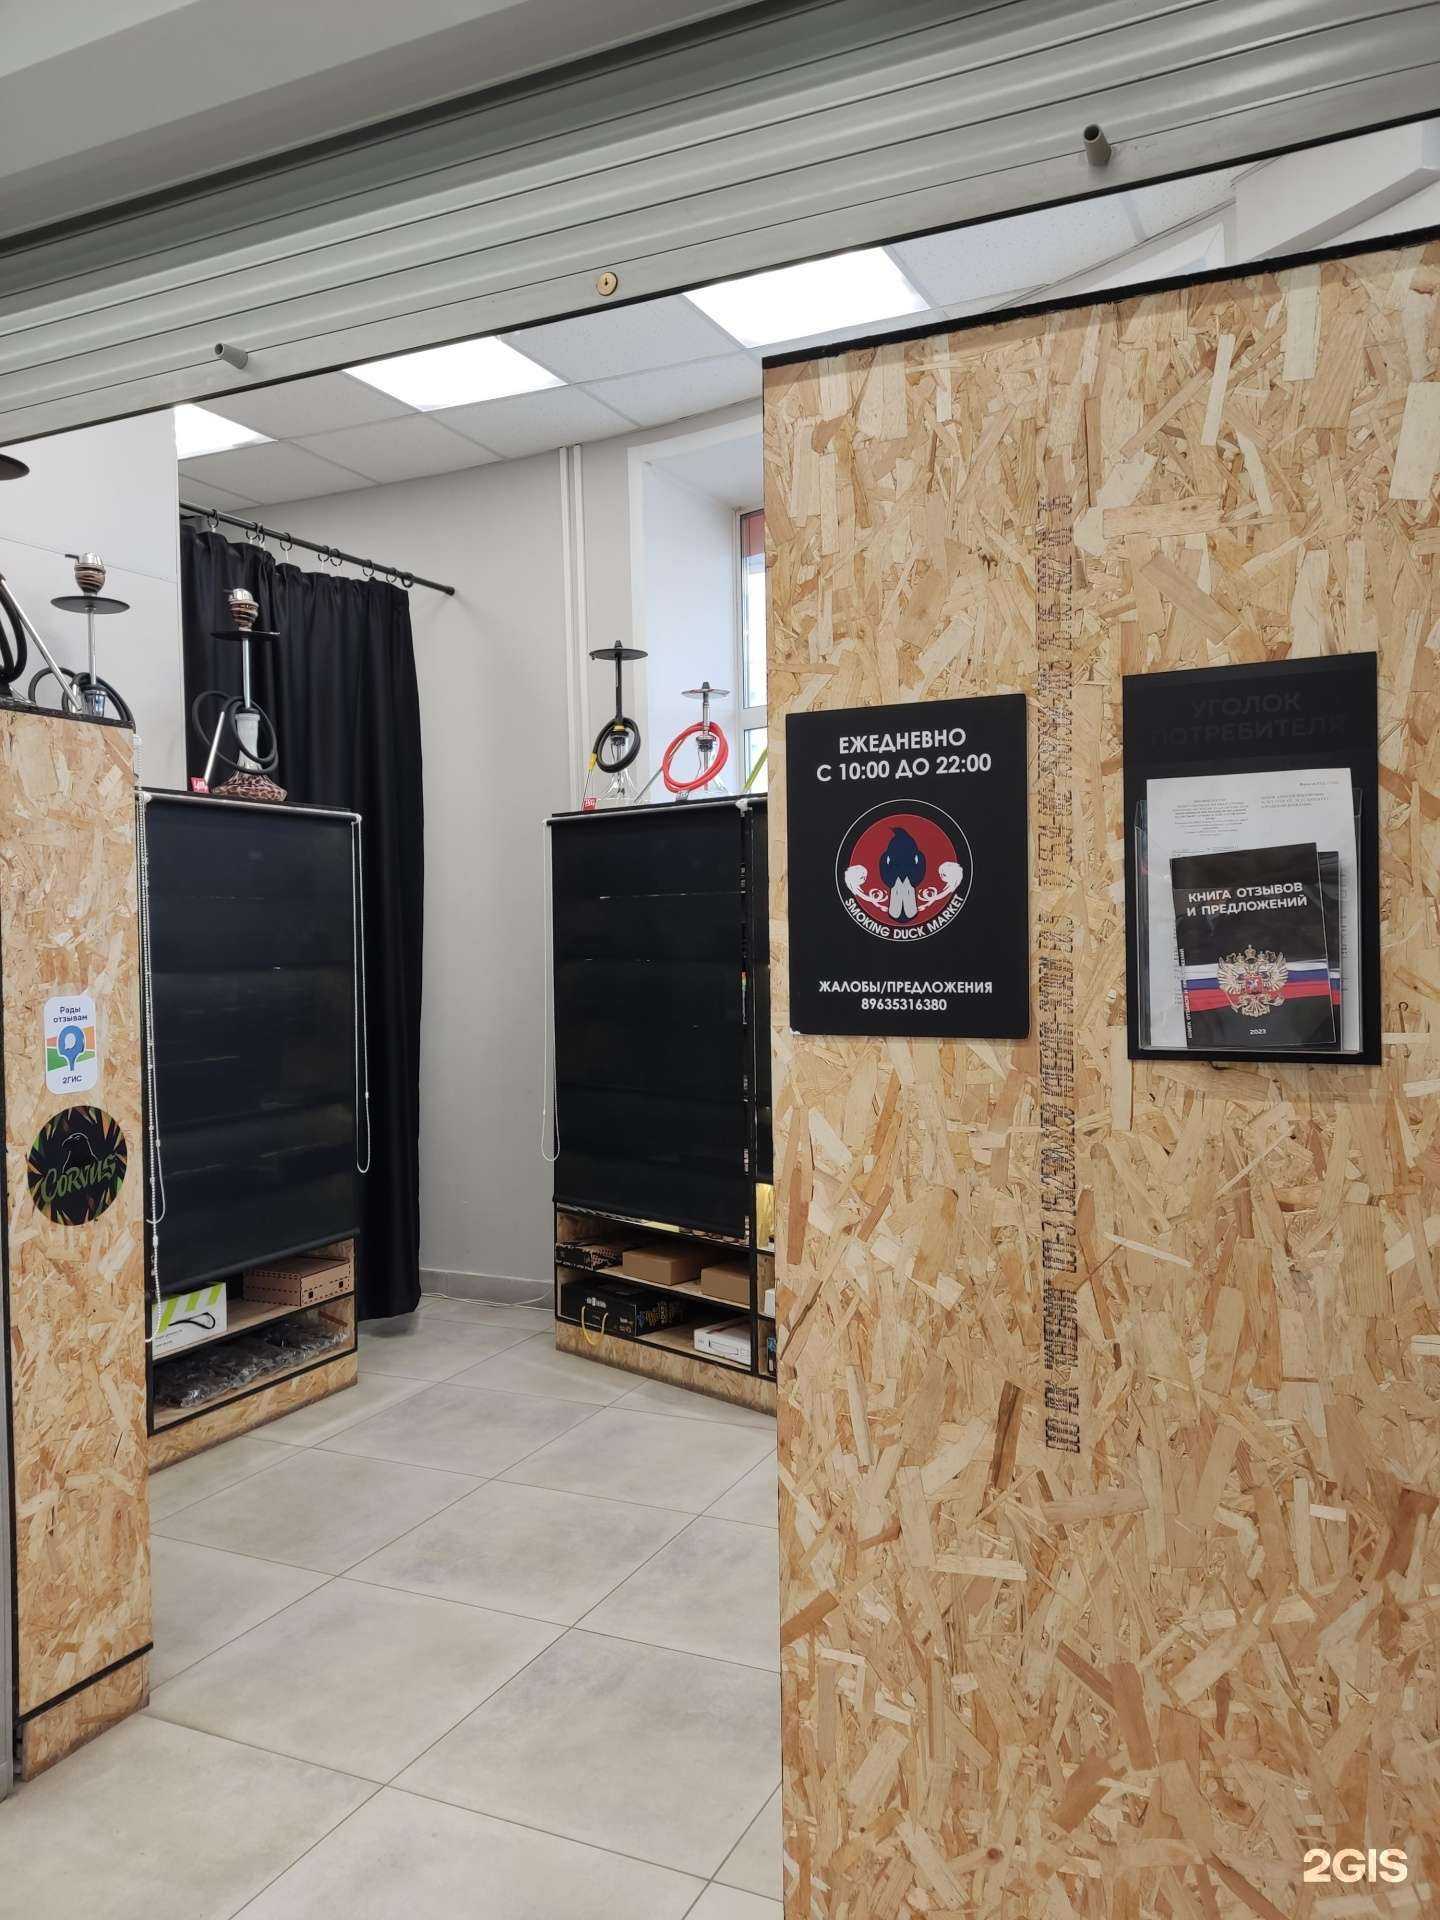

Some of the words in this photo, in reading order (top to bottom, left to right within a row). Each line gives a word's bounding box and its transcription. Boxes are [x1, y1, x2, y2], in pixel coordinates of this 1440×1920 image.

[1191, 691, 1302, 719] УГОЛОК
[1151, 712, 1347, 747] ПОТРЕБИТЕЛЯ
[838, 727, 967, 755] ЕЖЕДНЕВНО
[816, 764, 832, 782] С
[839, 760, 891, 781] 10:00
[895, 757, 930, 779] ДО
[935, 752, 992, 776] 22:00
[1188, 889, 1232, 903] КНИГА
[1236, 882, 1303, 898] ОТЗЫВОВ
[844, 897, 890, 938] SMOKING
[893, 927, 926, 940] DUCK
[927, 893, 965, 934] MARKET
[1186, 906, 1197, 917] И
[1201, 894, 1308, 916] ПРЕДЛОЖЕНИЙ
[818, 979, 993, 995] ЖАЛОБЫ/ПРЕДЛОЖЕНИЯ
[59, 1006, 81, 1015] Рады
[860, 998, 947, 1012] 89635316380
[53, 1014, 88, 1023] отзывам
[62, 1075, 82, 1084] 2ГИС
